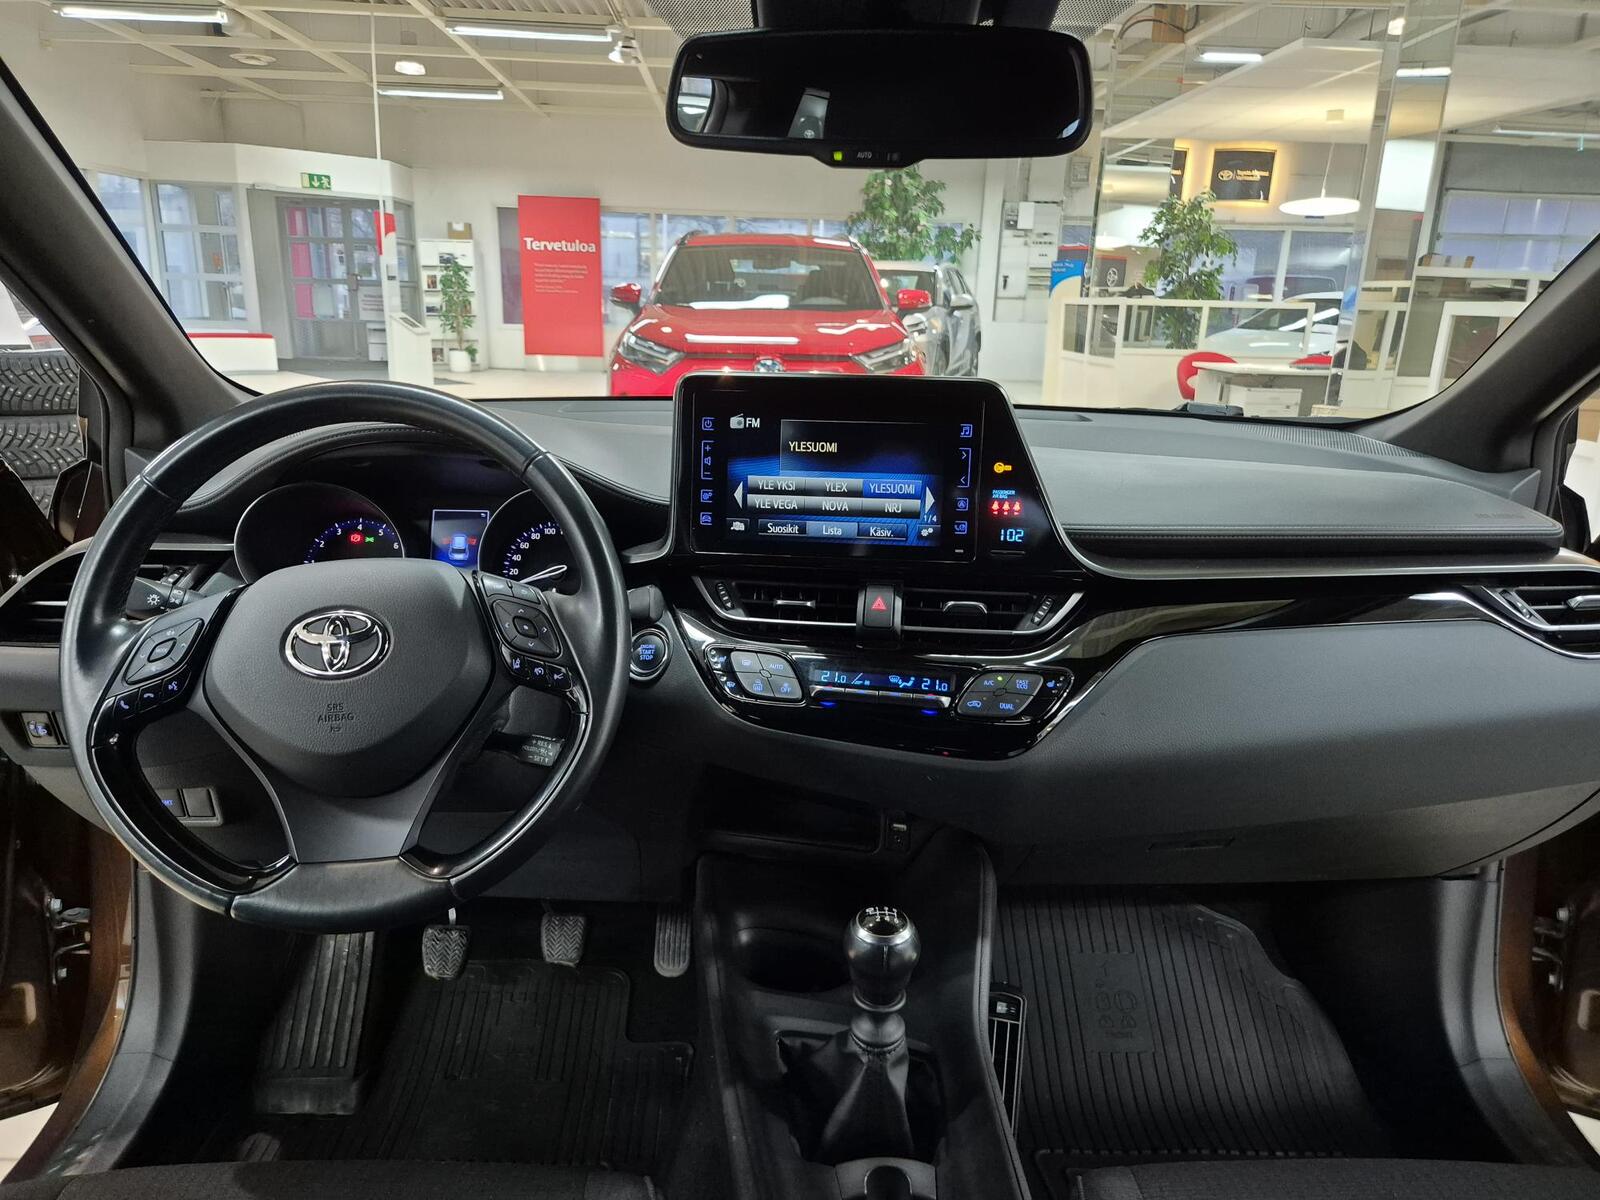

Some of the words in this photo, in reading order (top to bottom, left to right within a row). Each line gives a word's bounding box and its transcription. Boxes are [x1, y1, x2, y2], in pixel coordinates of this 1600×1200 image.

[523, 237, 596, 253] Tervetuloa
[745, 417, 760, 428] FM
[788, 441, 838, 453] YLESUOMI
[758, 479, 774, 490] YLE
[776, 480, 796, 491] YKSI
[825, 481, 848, 492] YLEX
[869, 483, 915, 494] YLESUOMI
[754, 498, 771, 509] YLE
[772, 499, 798, 510] VEGA
[822, 500, 849, 511] NOVA
[884, 503, 902, 513] NRJ
[924, 514, 937, 523] 1/4
[336, 528, 342, 536] 3
[378, 529, 384, 537] 5
[767, 522, 799, 534] Suosikit
[822, 524, 842, 536] Lista
[869, 526, 894, 537] Käsiv.
[1000, 529, 1024, 542] 102
[393, 542, 399, 550] 6
[512, 554, 522, 562] 40
[509, 568, 519, 576] 20
[821, 670, 847, 684] 21.0
[921, 678, 948, 692] 21.0
[327, 703, 344, 711] SRS
[317, 712, 355, 723] AIRBAG
